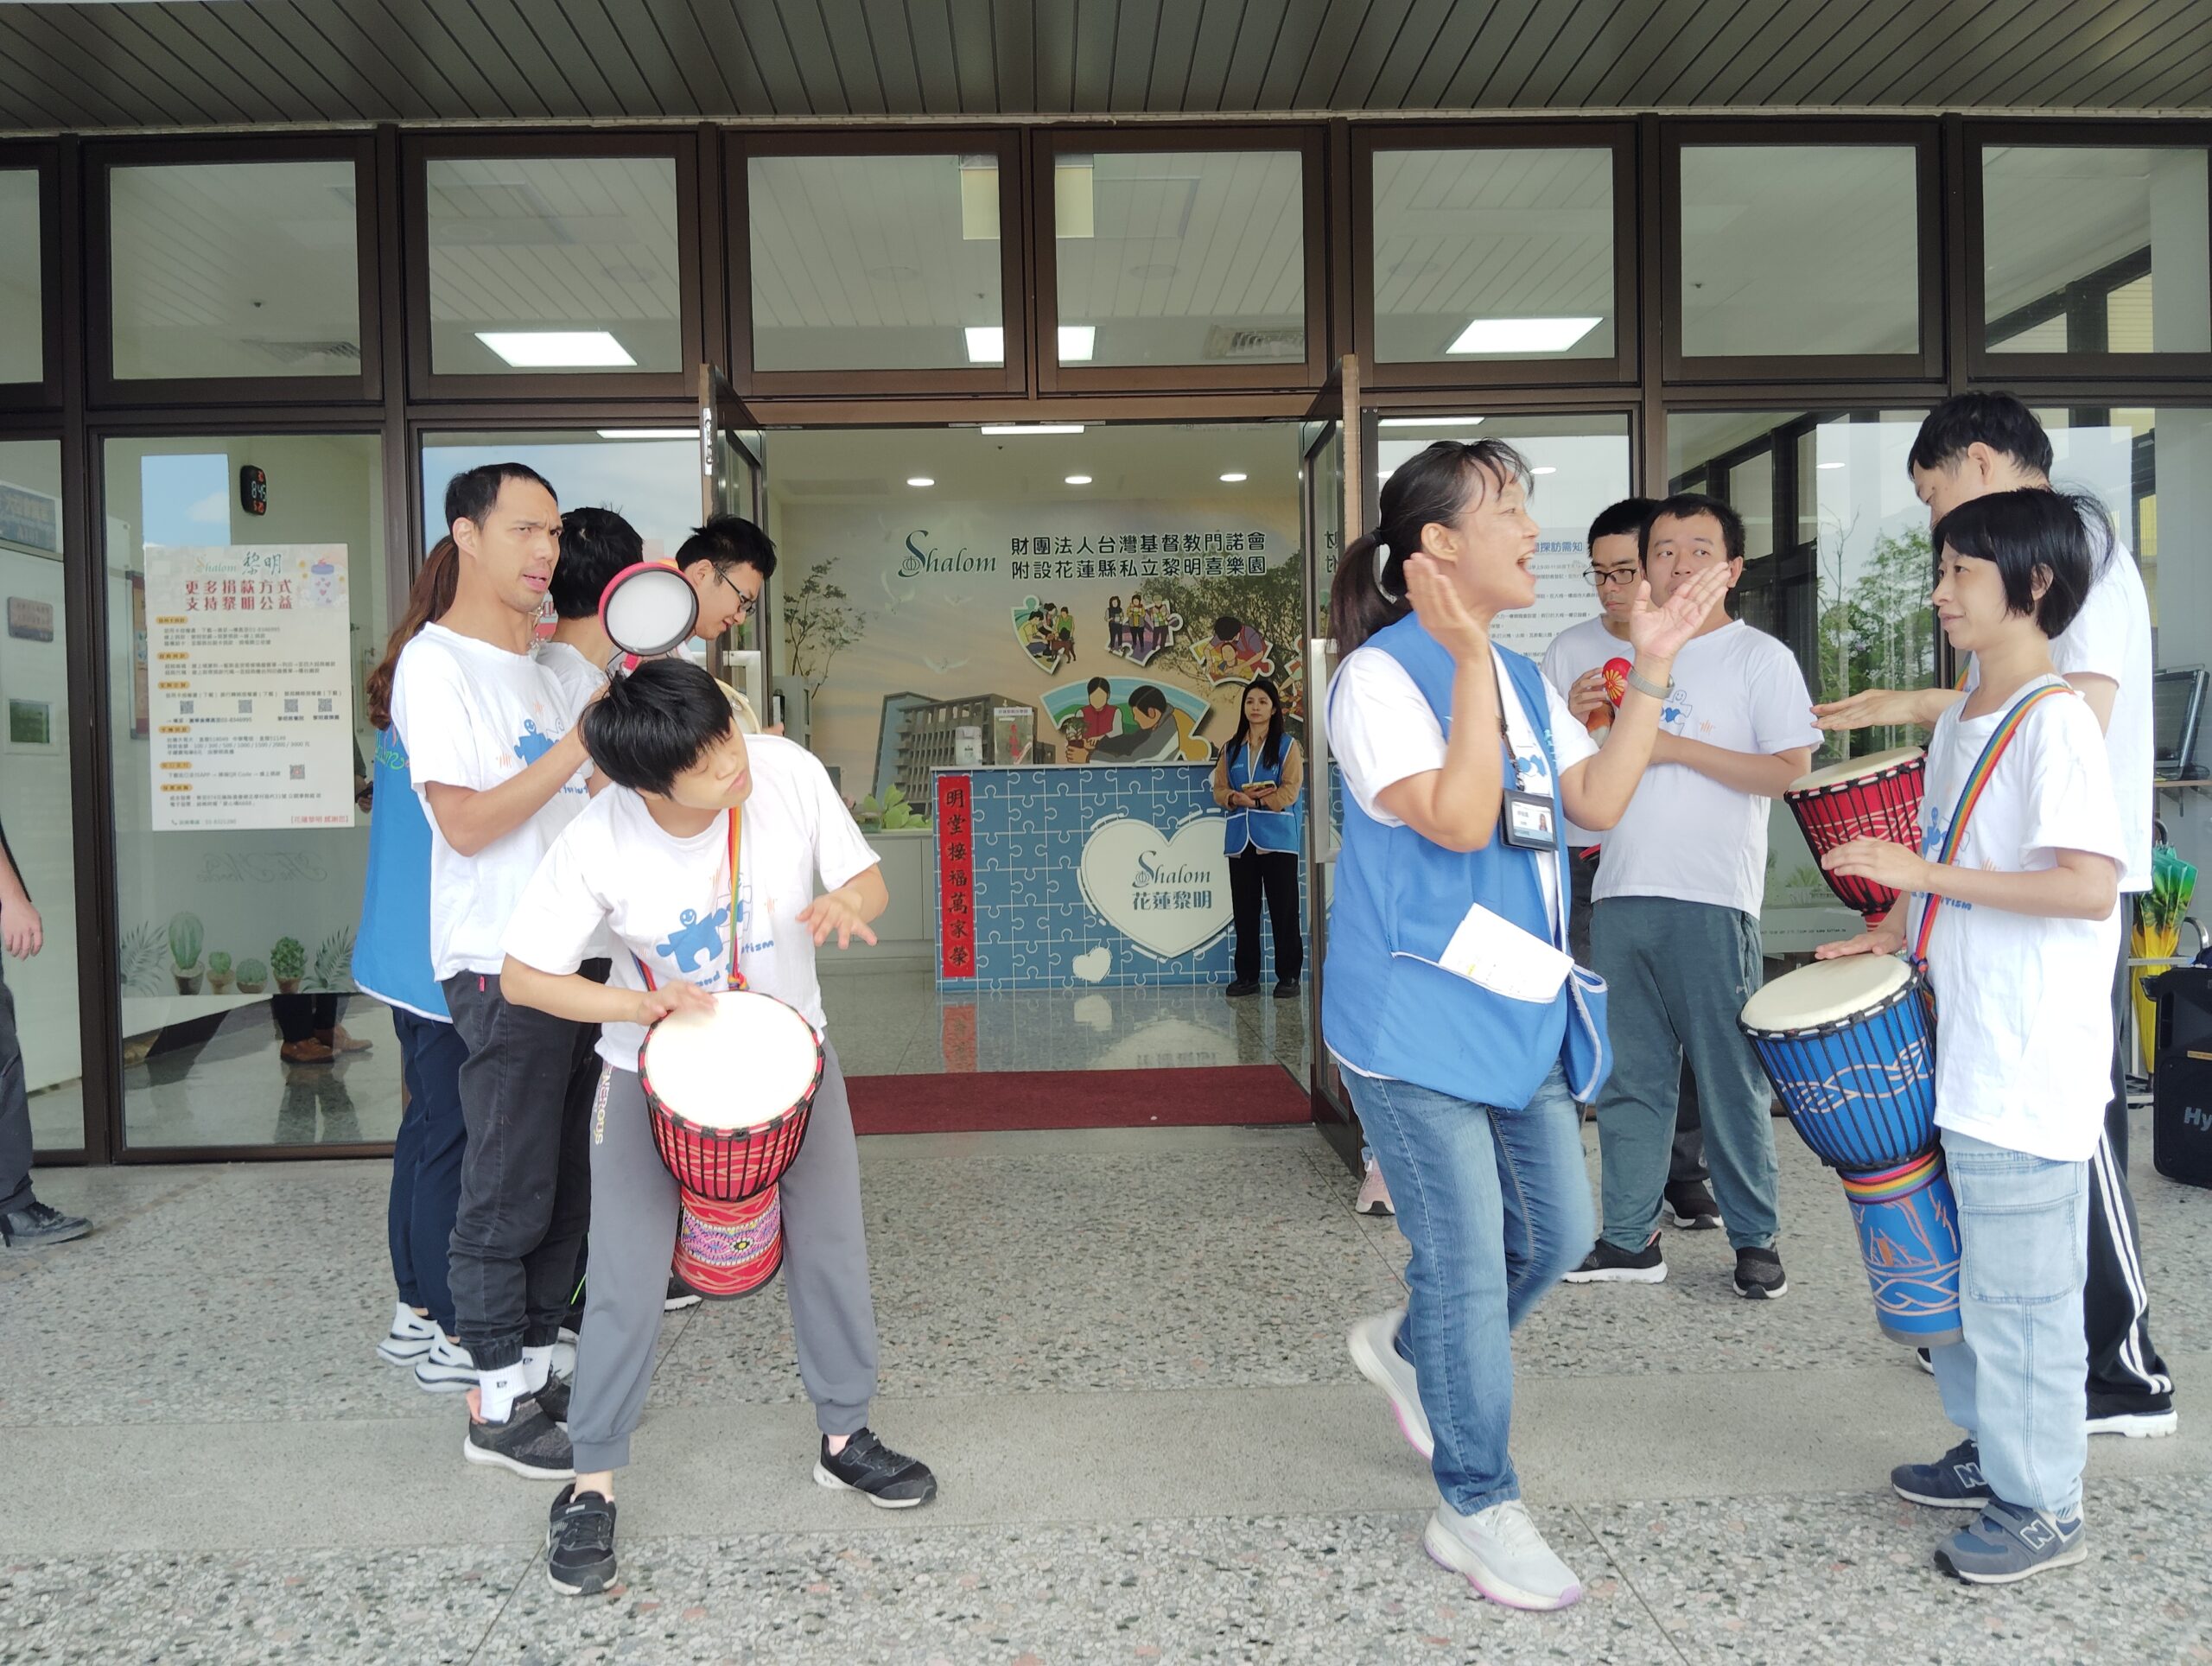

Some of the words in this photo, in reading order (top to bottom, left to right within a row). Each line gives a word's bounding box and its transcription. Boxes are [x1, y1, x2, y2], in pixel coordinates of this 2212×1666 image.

[897, 530, 997, 577] Shalom
[1009, 531, 1268, 556] 財團法人台灣基督教門諾會
[242, 551, 282, 575] 黎明
[1010, 556, 1268, 581] 附設花蓮縣私立黎明喜樂園
[185, 579, 293, 595] 更多捐款方式
[185, 595, 293, 611] 支持黎明公益
[946, 789, 969, 967] 明堂接福萬家榮
[1131, 850, 1211, 888] Shalom
[1132, 890, 1212, 911] 花蓮黎明
